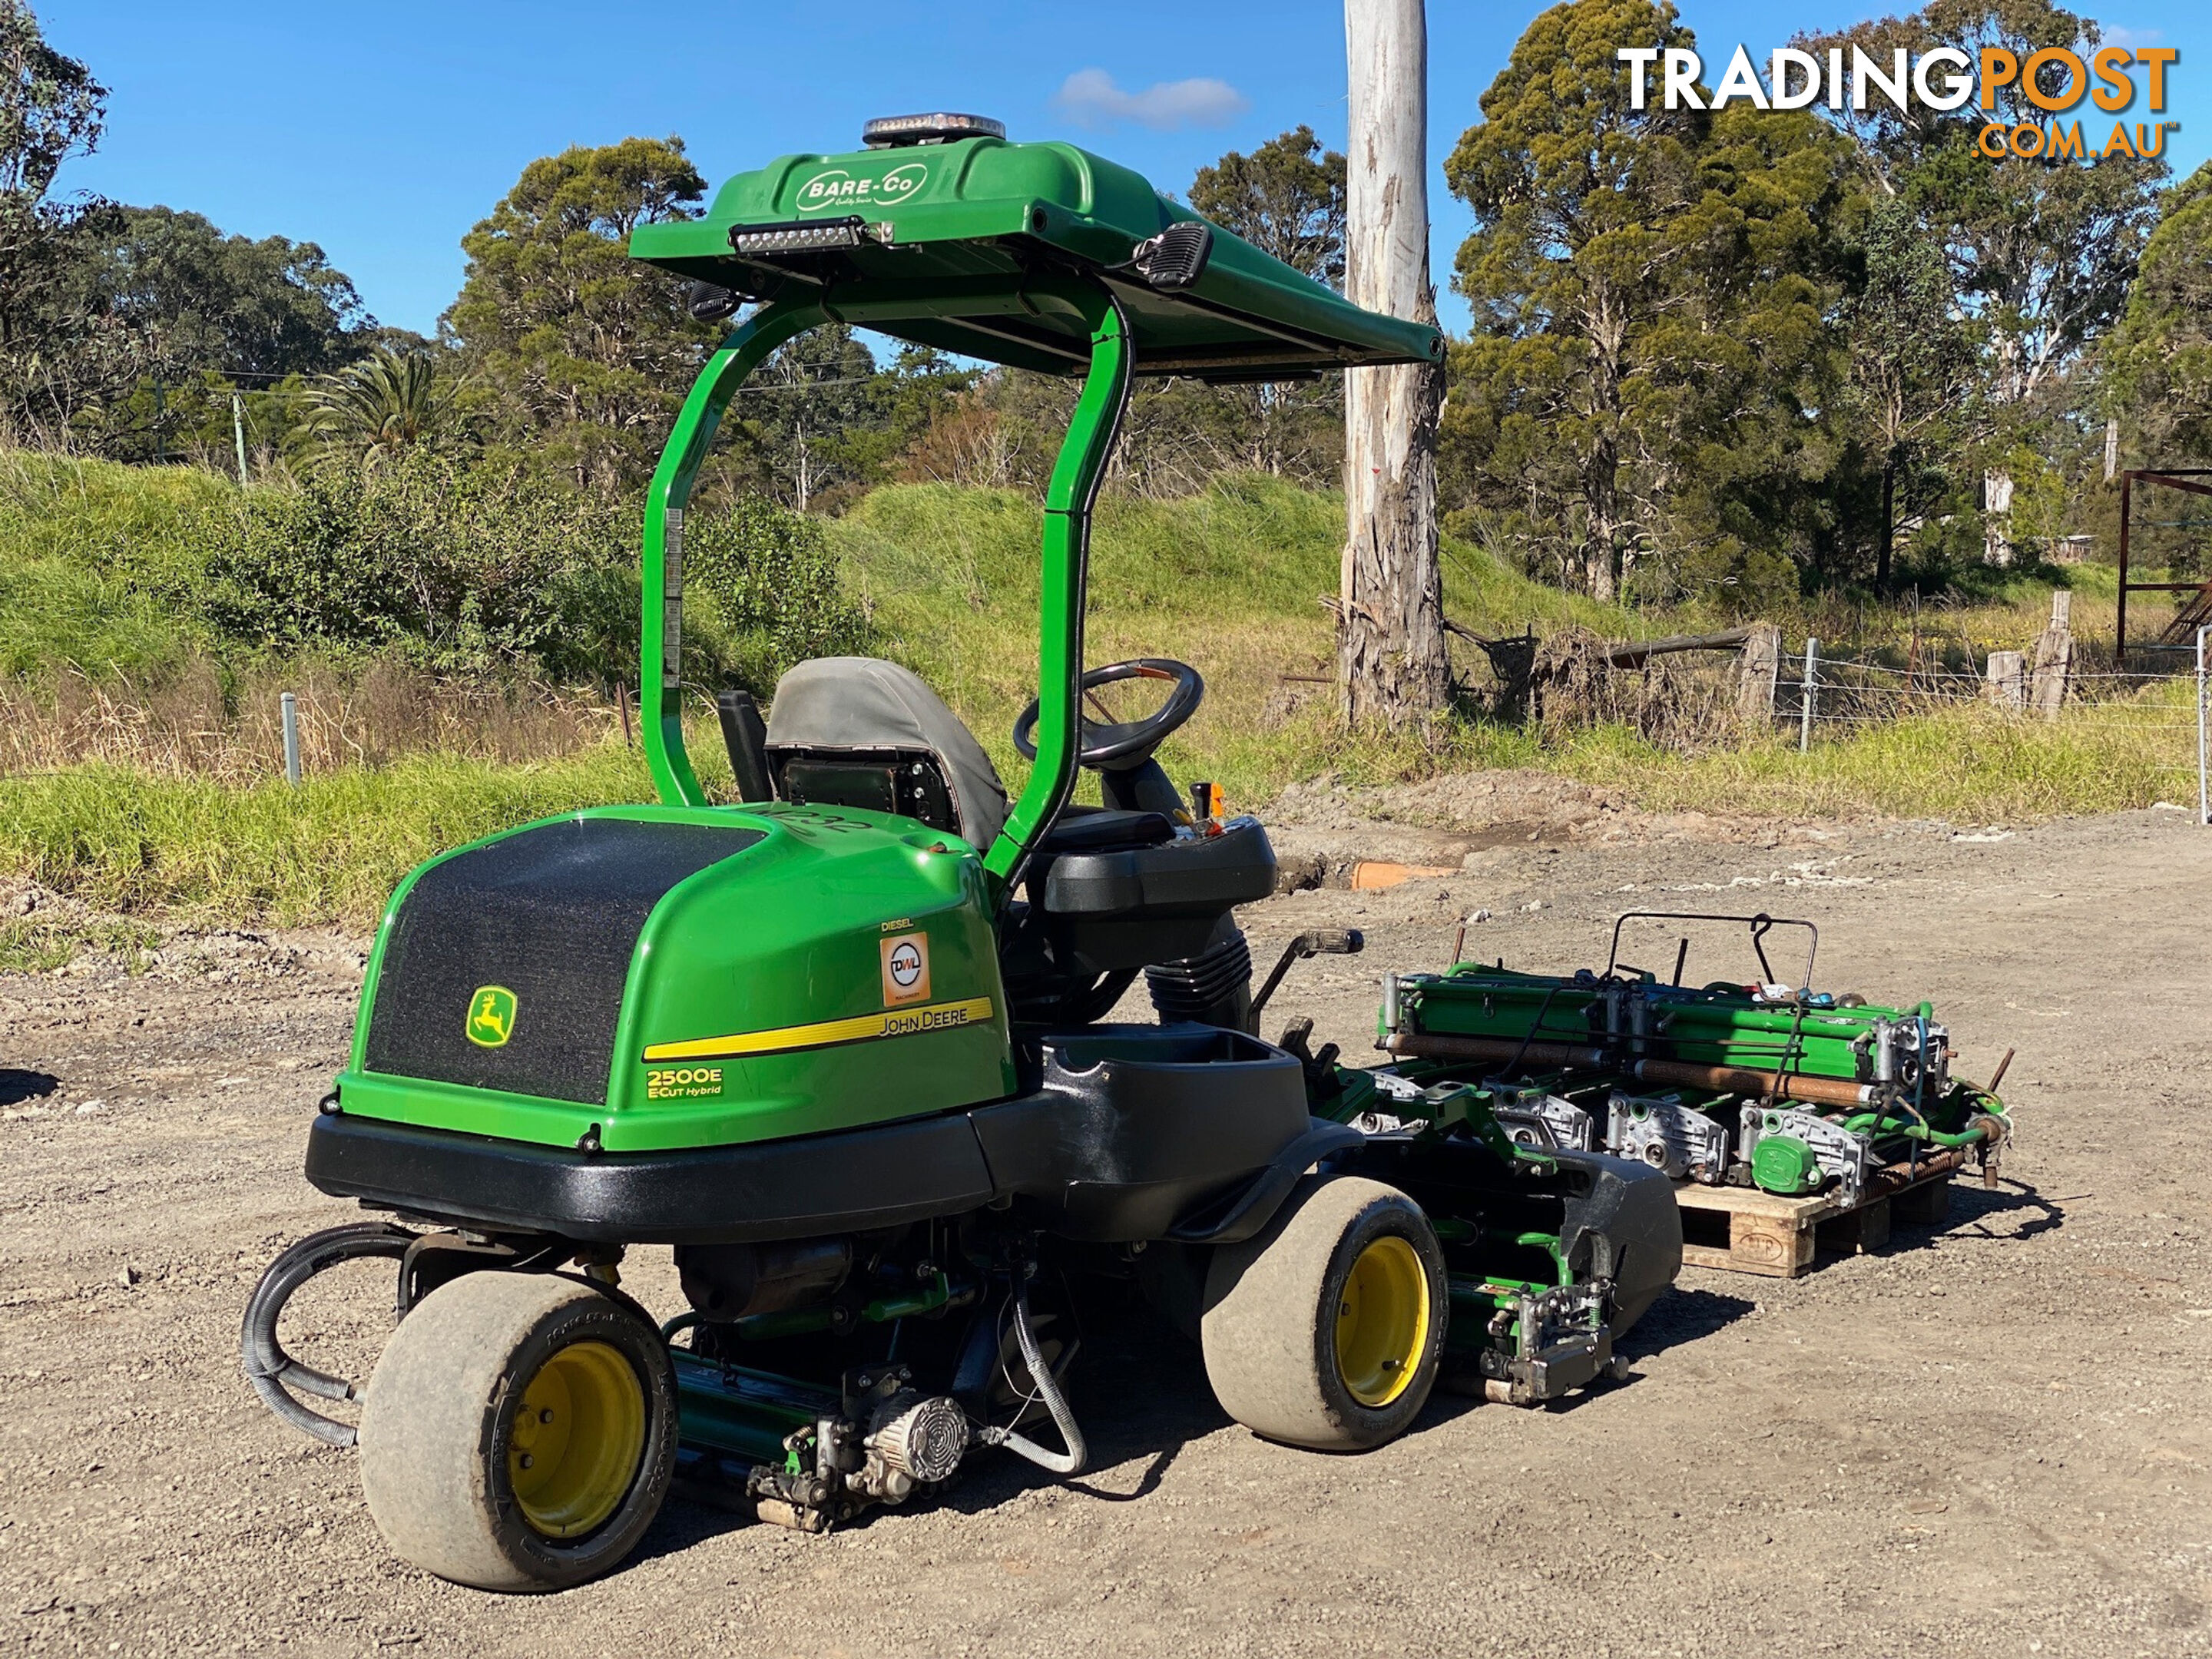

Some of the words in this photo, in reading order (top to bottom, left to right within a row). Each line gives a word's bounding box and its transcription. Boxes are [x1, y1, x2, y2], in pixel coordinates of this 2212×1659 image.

[882, 919, 914, 932] DIESEL
[879, 1016, 919, 1035] JOHN
[922, 1008, 969, 1028] DEERE
[647, 1068, 722, 1086] 2500E
[686, 1085, 721, 1097] Hybrid
